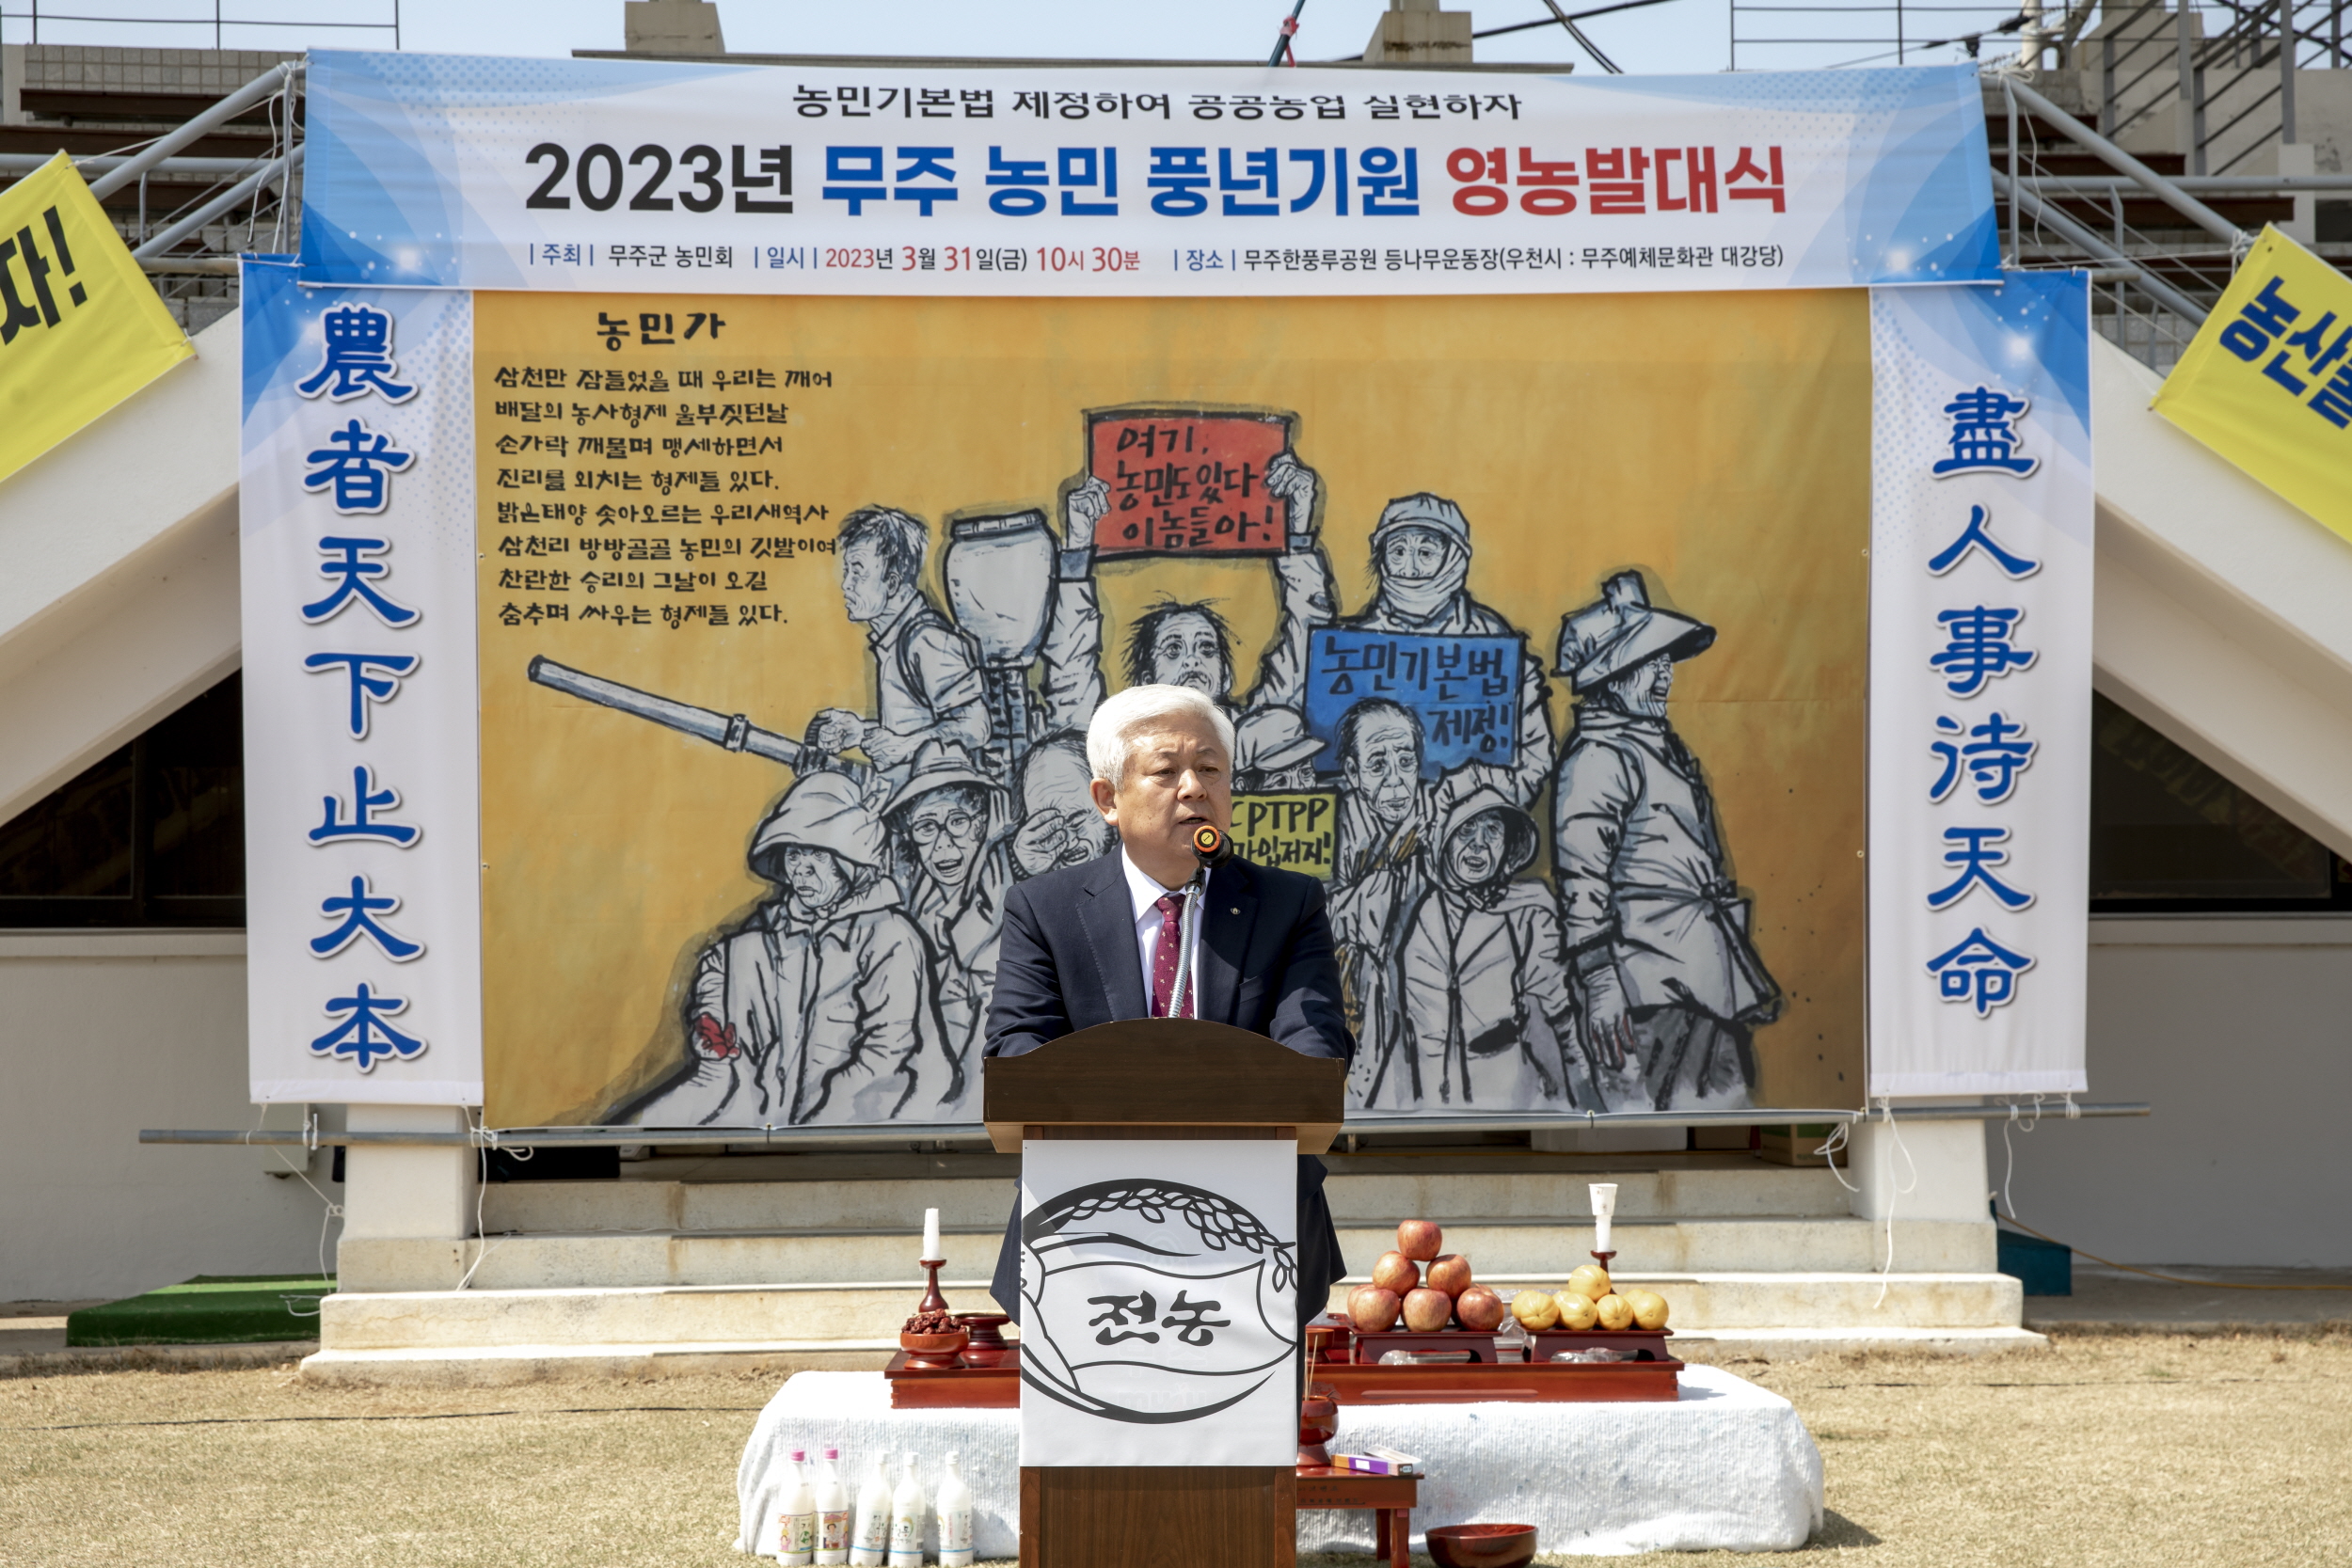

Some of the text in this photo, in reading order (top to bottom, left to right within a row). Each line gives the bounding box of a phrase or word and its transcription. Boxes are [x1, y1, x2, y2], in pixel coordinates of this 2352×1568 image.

[792, 85, 1522, 120] 농민기본법 제정하여 공공농업 실현하자
[525, 142, 1787, 217] 2023년 무주 농민 풍년기원 영농발대식
[542, 244, 580, 266] 주최
[608, 245, 668, 267] 무주군
[675, 245, 733, 269] 농민회
[767, 246, 804, 269] 일시
[826, 247, 893, 270] 2023년
[902, 245, 935, 271] 3월
[944, 246, 1027, 272] 31일(금)
[1037, 246, 1084, 272] 10시
[1092, 246, 1140, 272] 30분
[1186, 248, 1224, 272] 장소
[1244, 248, 1376, 272] 무주한풍루공원
[1581, 246, 1714, 269] 무주예체문화관
[1721, 245, 1784, 267] 대강당)
[596, 311, 726, 352] 농민가
[494, 366, 833, 393] 삼천만 잠들었을 때 우리는 깨어
[495, 401, 563, 423] 배달의
[571, 403, 667, 429] 농사형제
[495, 434, 783, 460] 손가락 깨물며 맹세하면서
[496, 468, 779, 497] 진리를 외치는 형제들 있다.
[497, 501, 830, 528] 밝은태양 솟아오르는 우리새역사
[1122, 505, 1274, 548] 이놈들아!
[498, 534, 836, 562] 삼천리 방방골골 농민의 깃발이여
[498, 568, 768, 594] 찬란한 승리의 그날이 오길
[498, 602, 787, 630] 춤추며 싸우는 형제들 있다.
[1321, 636, 1508, 701] 농민기본법
[1426, 704, 1509, 753] 제정!
[1087, 1290, 1232, 1346] 전농
